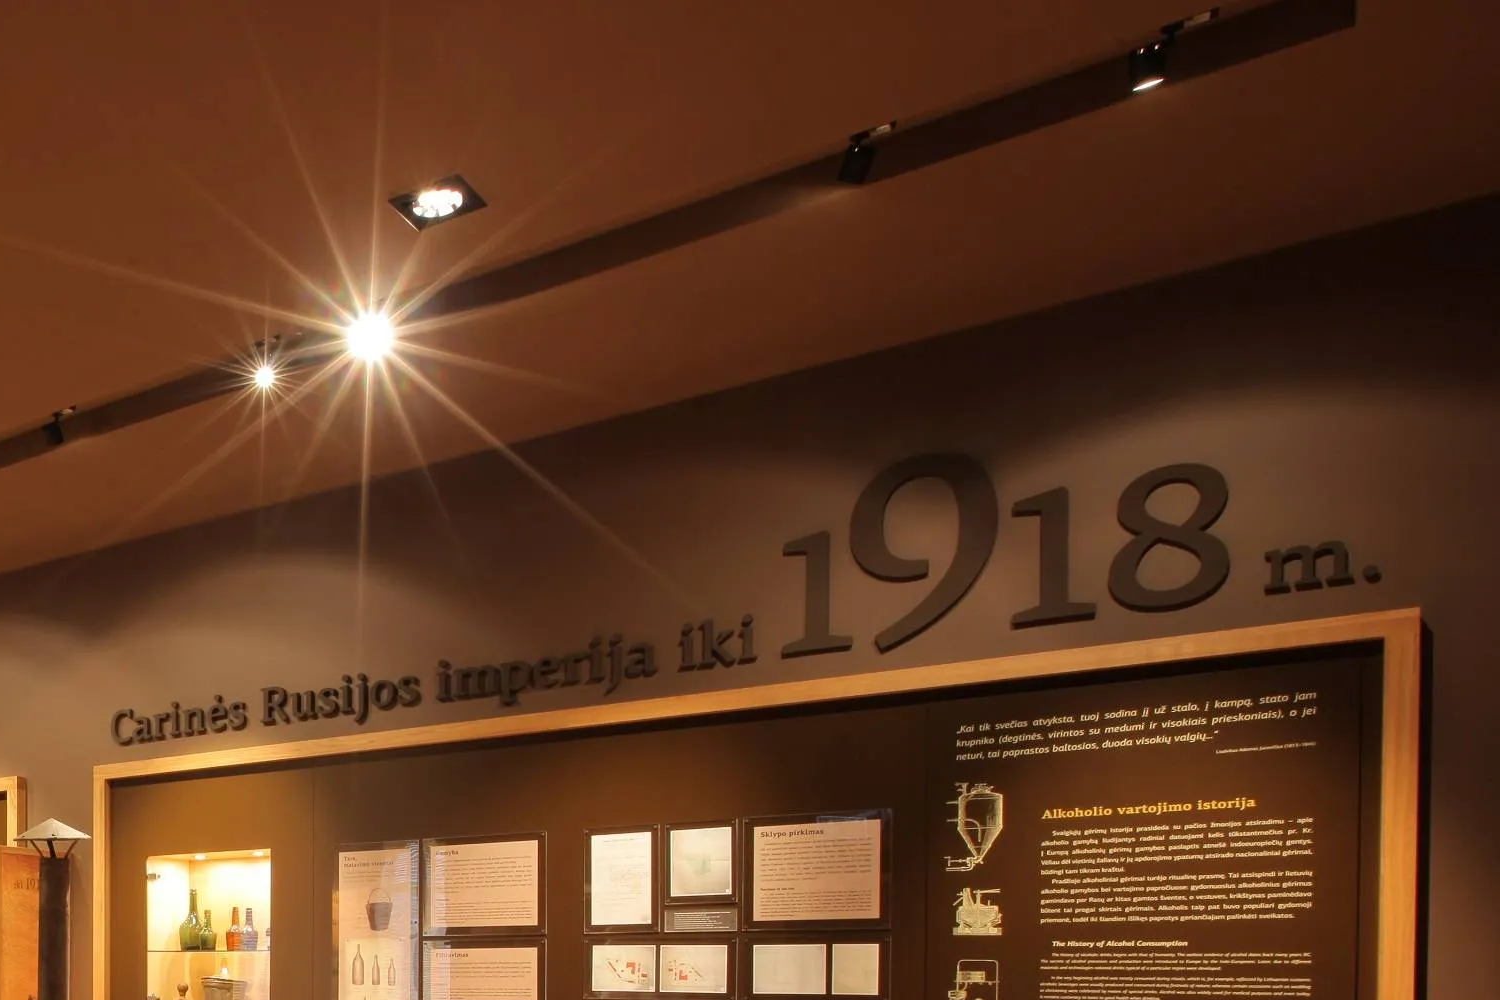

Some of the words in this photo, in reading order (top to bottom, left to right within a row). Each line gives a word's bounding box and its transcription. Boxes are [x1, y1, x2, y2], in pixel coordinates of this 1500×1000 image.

[111, 692, 249, 746] Carinės
[261, 671, 422, 726] Rusijos
[436, 631, 658, 709] imperija
[678, 613, 757, 674] iki
[781, 451, 1231, 660] 1918
[1263, 537, 1384, 597] m.
[956, 724, 974, 734] „Kai
[978, 722, 991, 731] tik
[1032, 715, 1075, 726] atvyksta,
[1079, 711, 1099, 722] tuoj
[1103, 709, 1137, 719] sodina
[1141, 706, 1149, 717] jį
[1153, 704, 1166, 714] už
[1170, 701, 1200, 712] stalo,
[1203, 700, 1209, 711] į
[1258, 694, 1289, 704] stato
[1292, 691, 1316, 702] jam
[955, 736, 995, 747] krupniko
[1047, 729, 1084, 738] virintos
[1088, 727, 1100, 735] su
[1104, 721, 1145, 733] medumi
[1148, 721, 1157, 729] ir
[1161, 716, 1207, 728] visokiais
[1300, 706, 1317, 718] jei
[955, 751, 984, 760] neturi,
[987, 749, 1000, 758] tai
[1001, 746, 1049, 758] paprastos
[1101, 737, 1132, 748] duoda
[1040, 805, 1112, 819] Alkoholio
[1116, 801, 1192, 815] vartojimo
[1196, 796, 1256, 810] istorija
[760, 830, 787, 839] Sklypo
[789, 828, 824, 838] pirkimas
[1066, 940, 1094, 948] History
